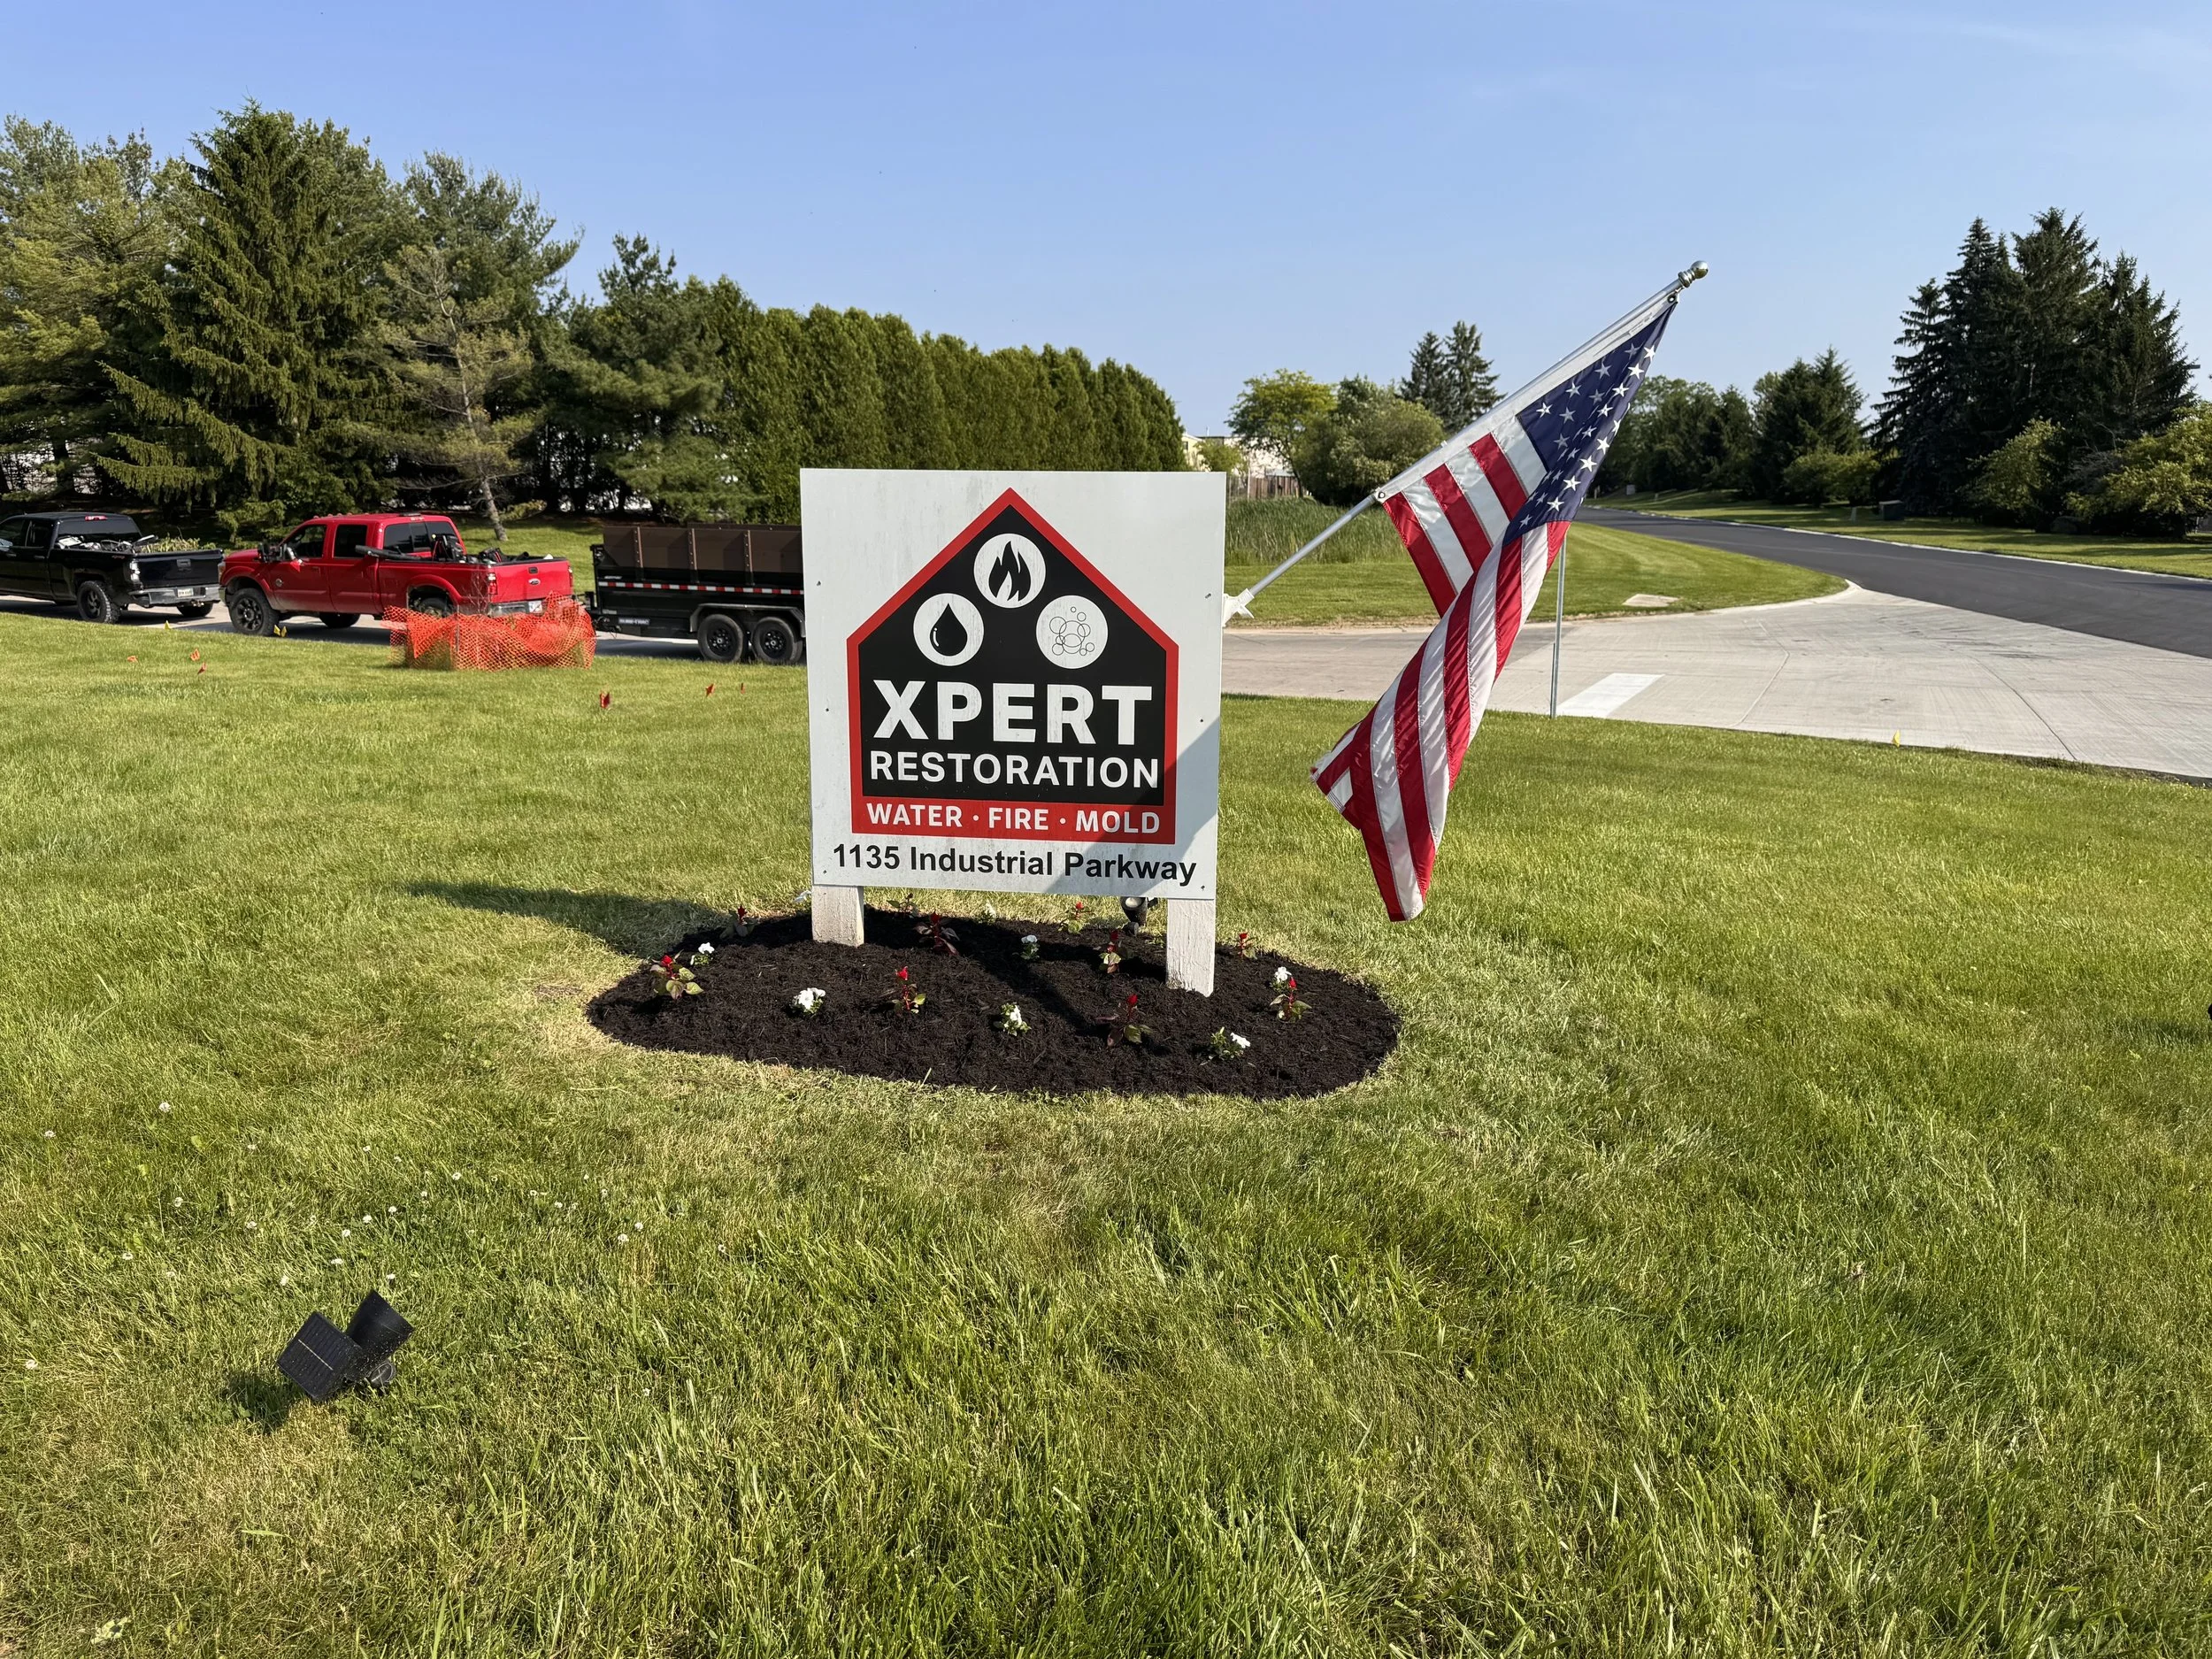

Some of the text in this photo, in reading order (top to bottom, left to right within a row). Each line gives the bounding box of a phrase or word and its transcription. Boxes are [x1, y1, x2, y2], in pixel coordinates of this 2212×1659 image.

[873, 680, 1152, 745] XPERT
[870, 750, 1158, 788] RESTORATION
[866, 803, 1160, 834] WATER FIRE MOLD
[833, 843, 1197, 887] 1135 Industrial Parkway
